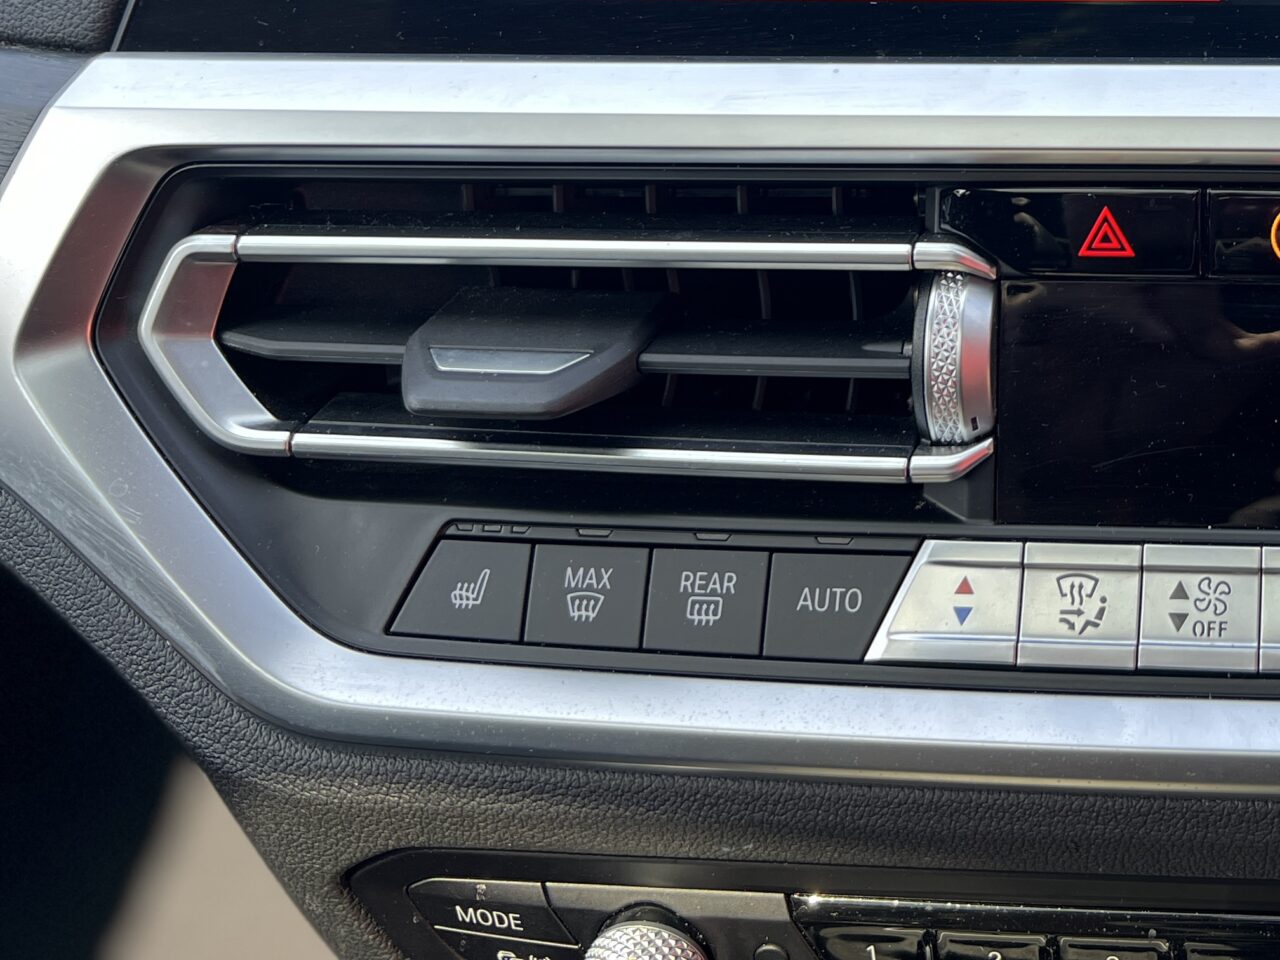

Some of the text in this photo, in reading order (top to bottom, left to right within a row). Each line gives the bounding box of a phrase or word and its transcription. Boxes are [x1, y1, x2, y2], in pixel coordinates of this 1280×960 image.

[564, 567, 614, 590] MAX
[680, 572, 737, 594] REAR
[796, 587, 863, 613] AUTO
[1192, 620, 1228, 638] OFF
[455, 904, 524, 932] MODE
